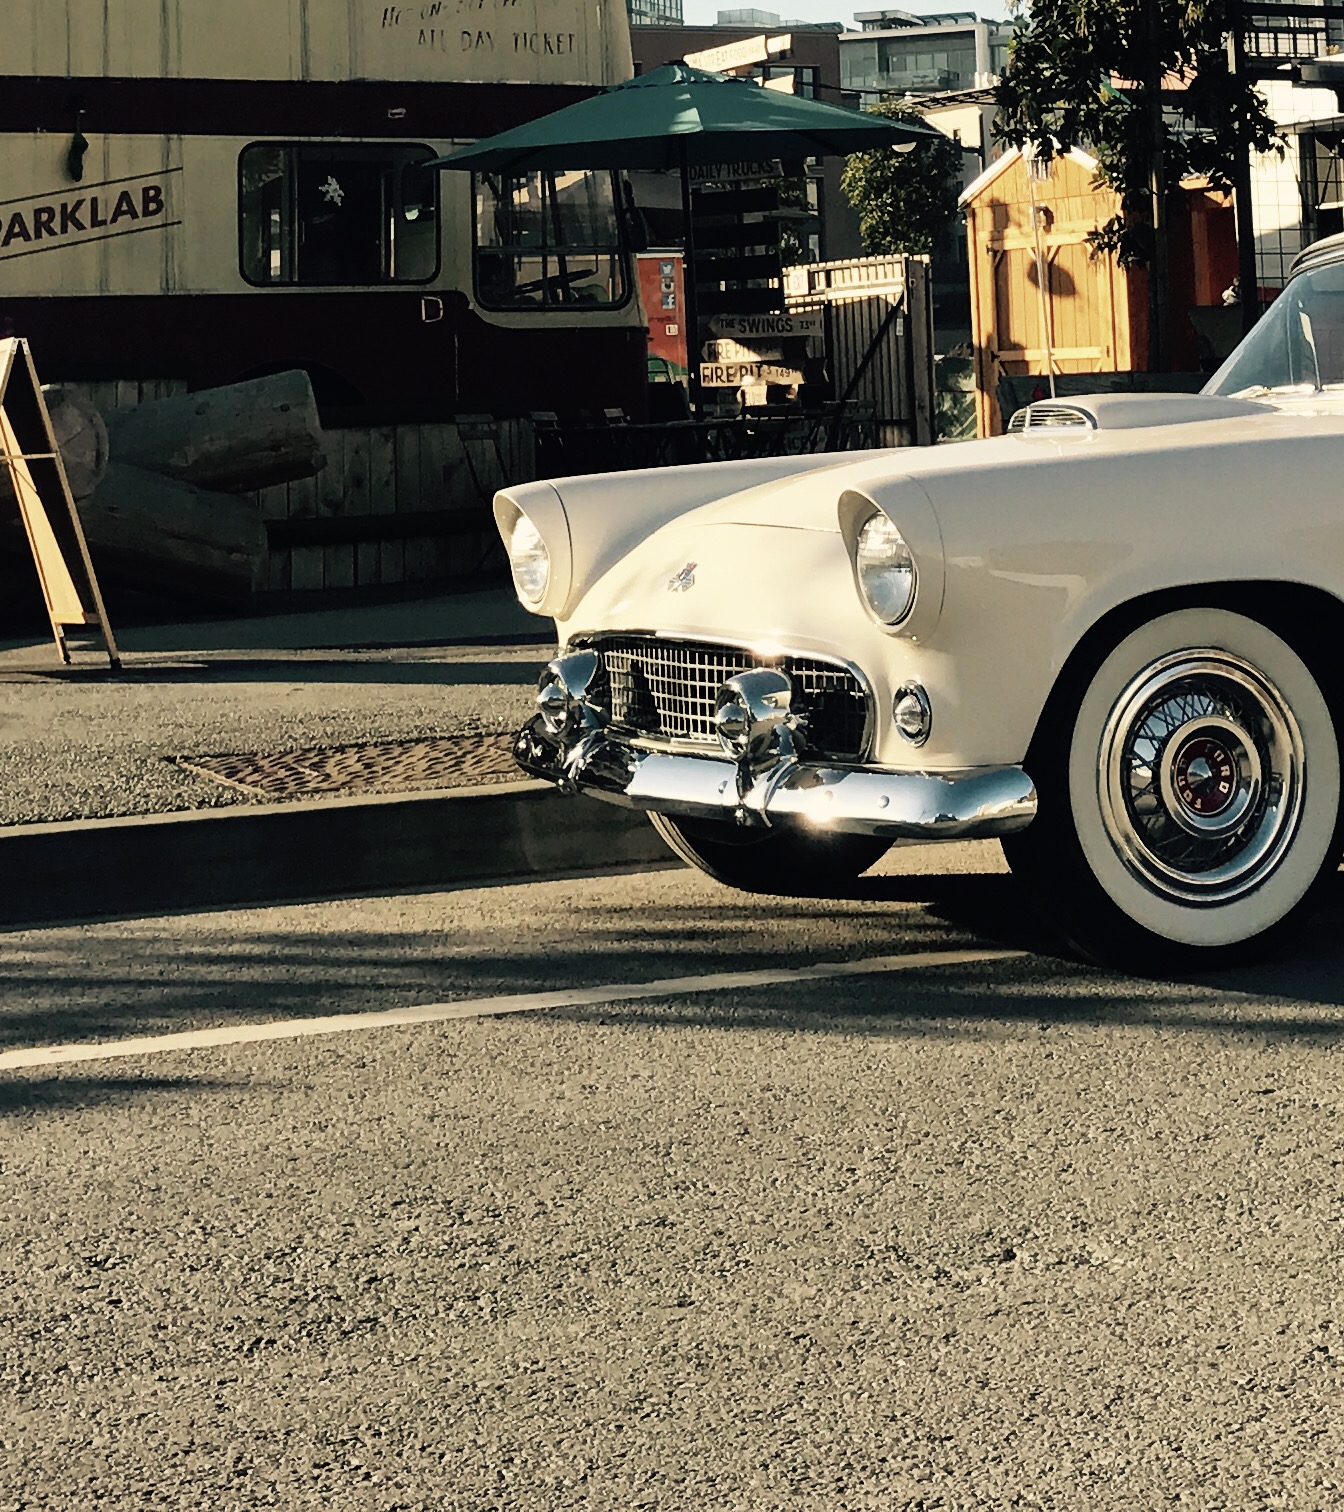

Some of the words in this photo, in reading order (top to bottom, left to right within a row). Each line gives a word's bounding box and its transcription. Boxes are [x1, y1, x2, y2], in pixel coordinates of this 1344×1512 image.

[461, 30, 494, 52] DAY
[513, 31, 575, 55] TICKET
[689, 162, 722, 180] DAILY
[724, 159, 774, 178] TRUCKS
[720, 318, 735, 328] THE
[739, 317, 793, 333] SWINGS
[702, 365, 734, 383] FIRE
[739, 364, 762, 382] PIT
